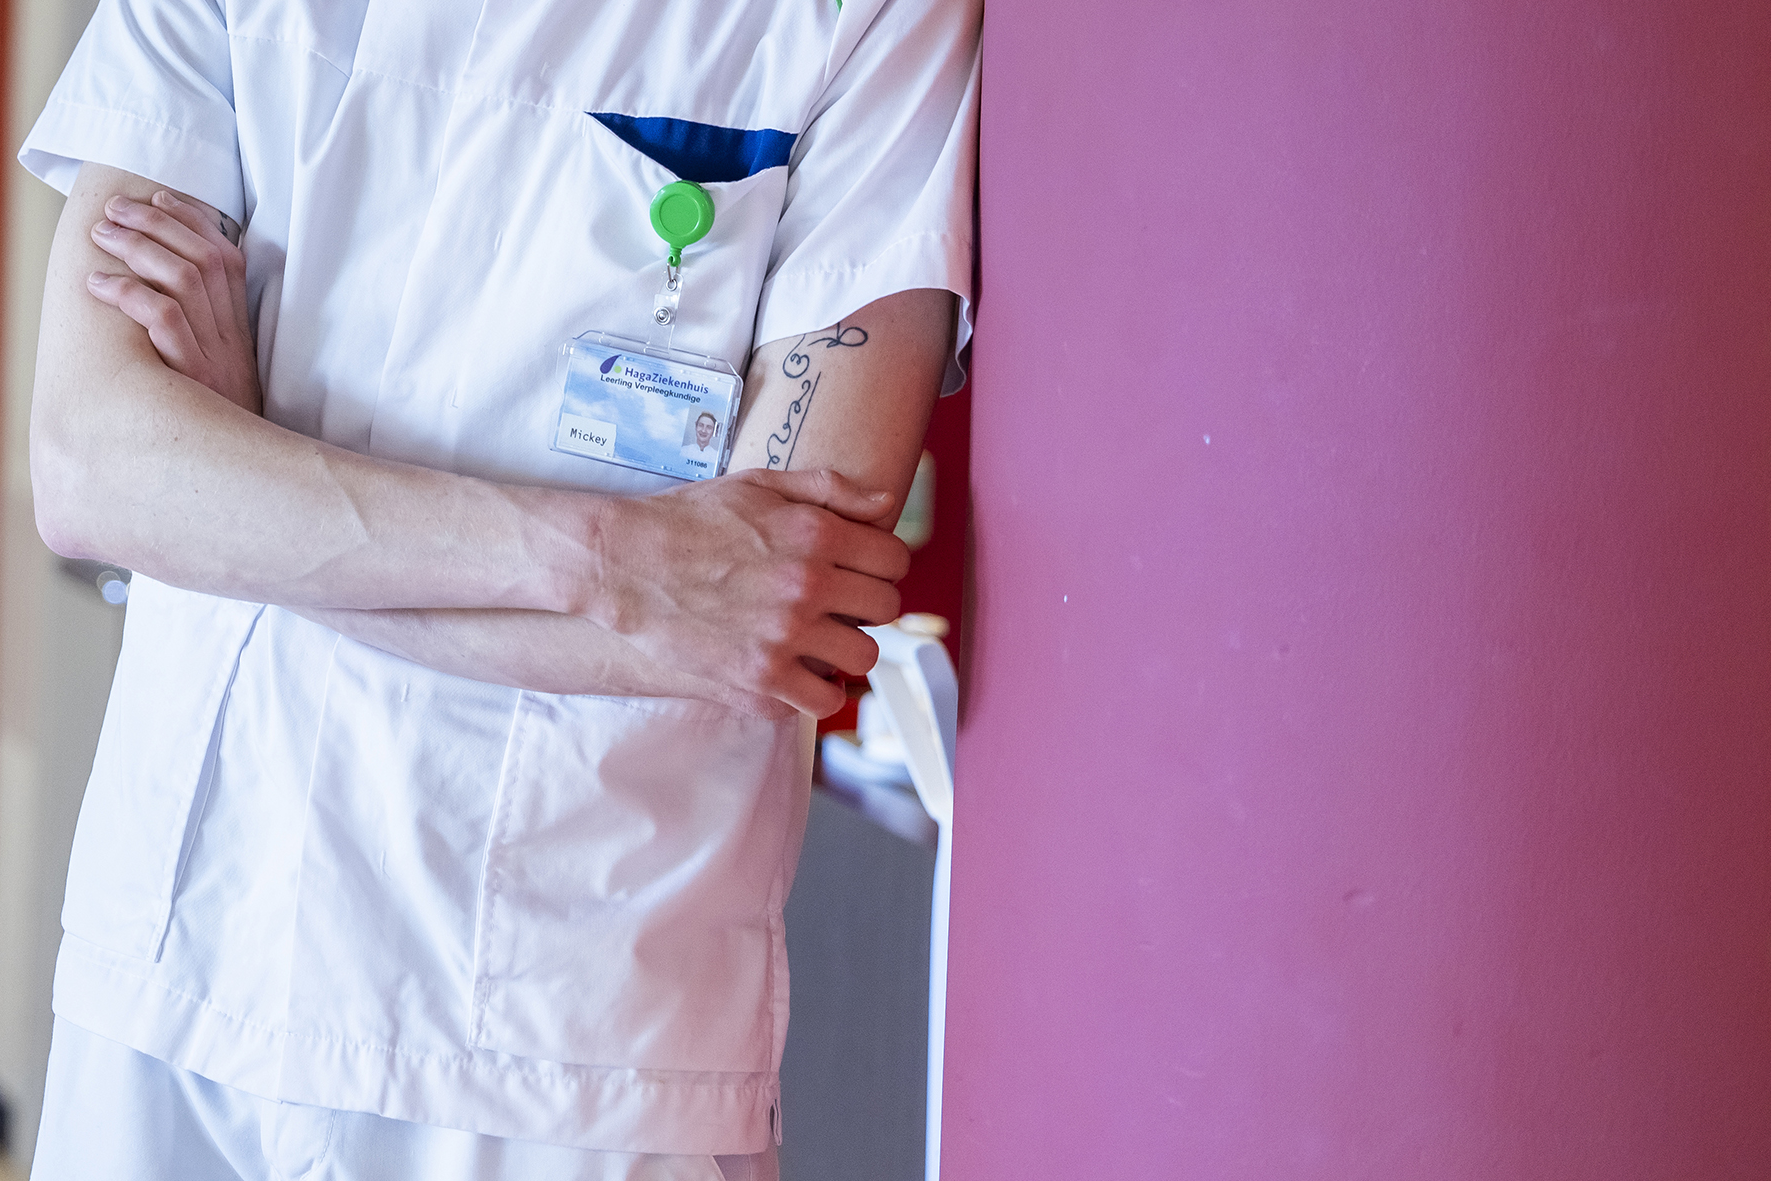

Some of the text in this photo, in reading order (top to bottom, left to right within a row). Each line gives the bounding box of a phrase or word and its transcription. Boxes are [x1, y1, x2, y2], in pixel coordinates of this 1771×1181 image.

[600, 374, 701, 404] Leerling Verpleegkundige
[624, 367, 709, 394] HagaZiekenhuis
[569, 428, 608, 447] Mickey
